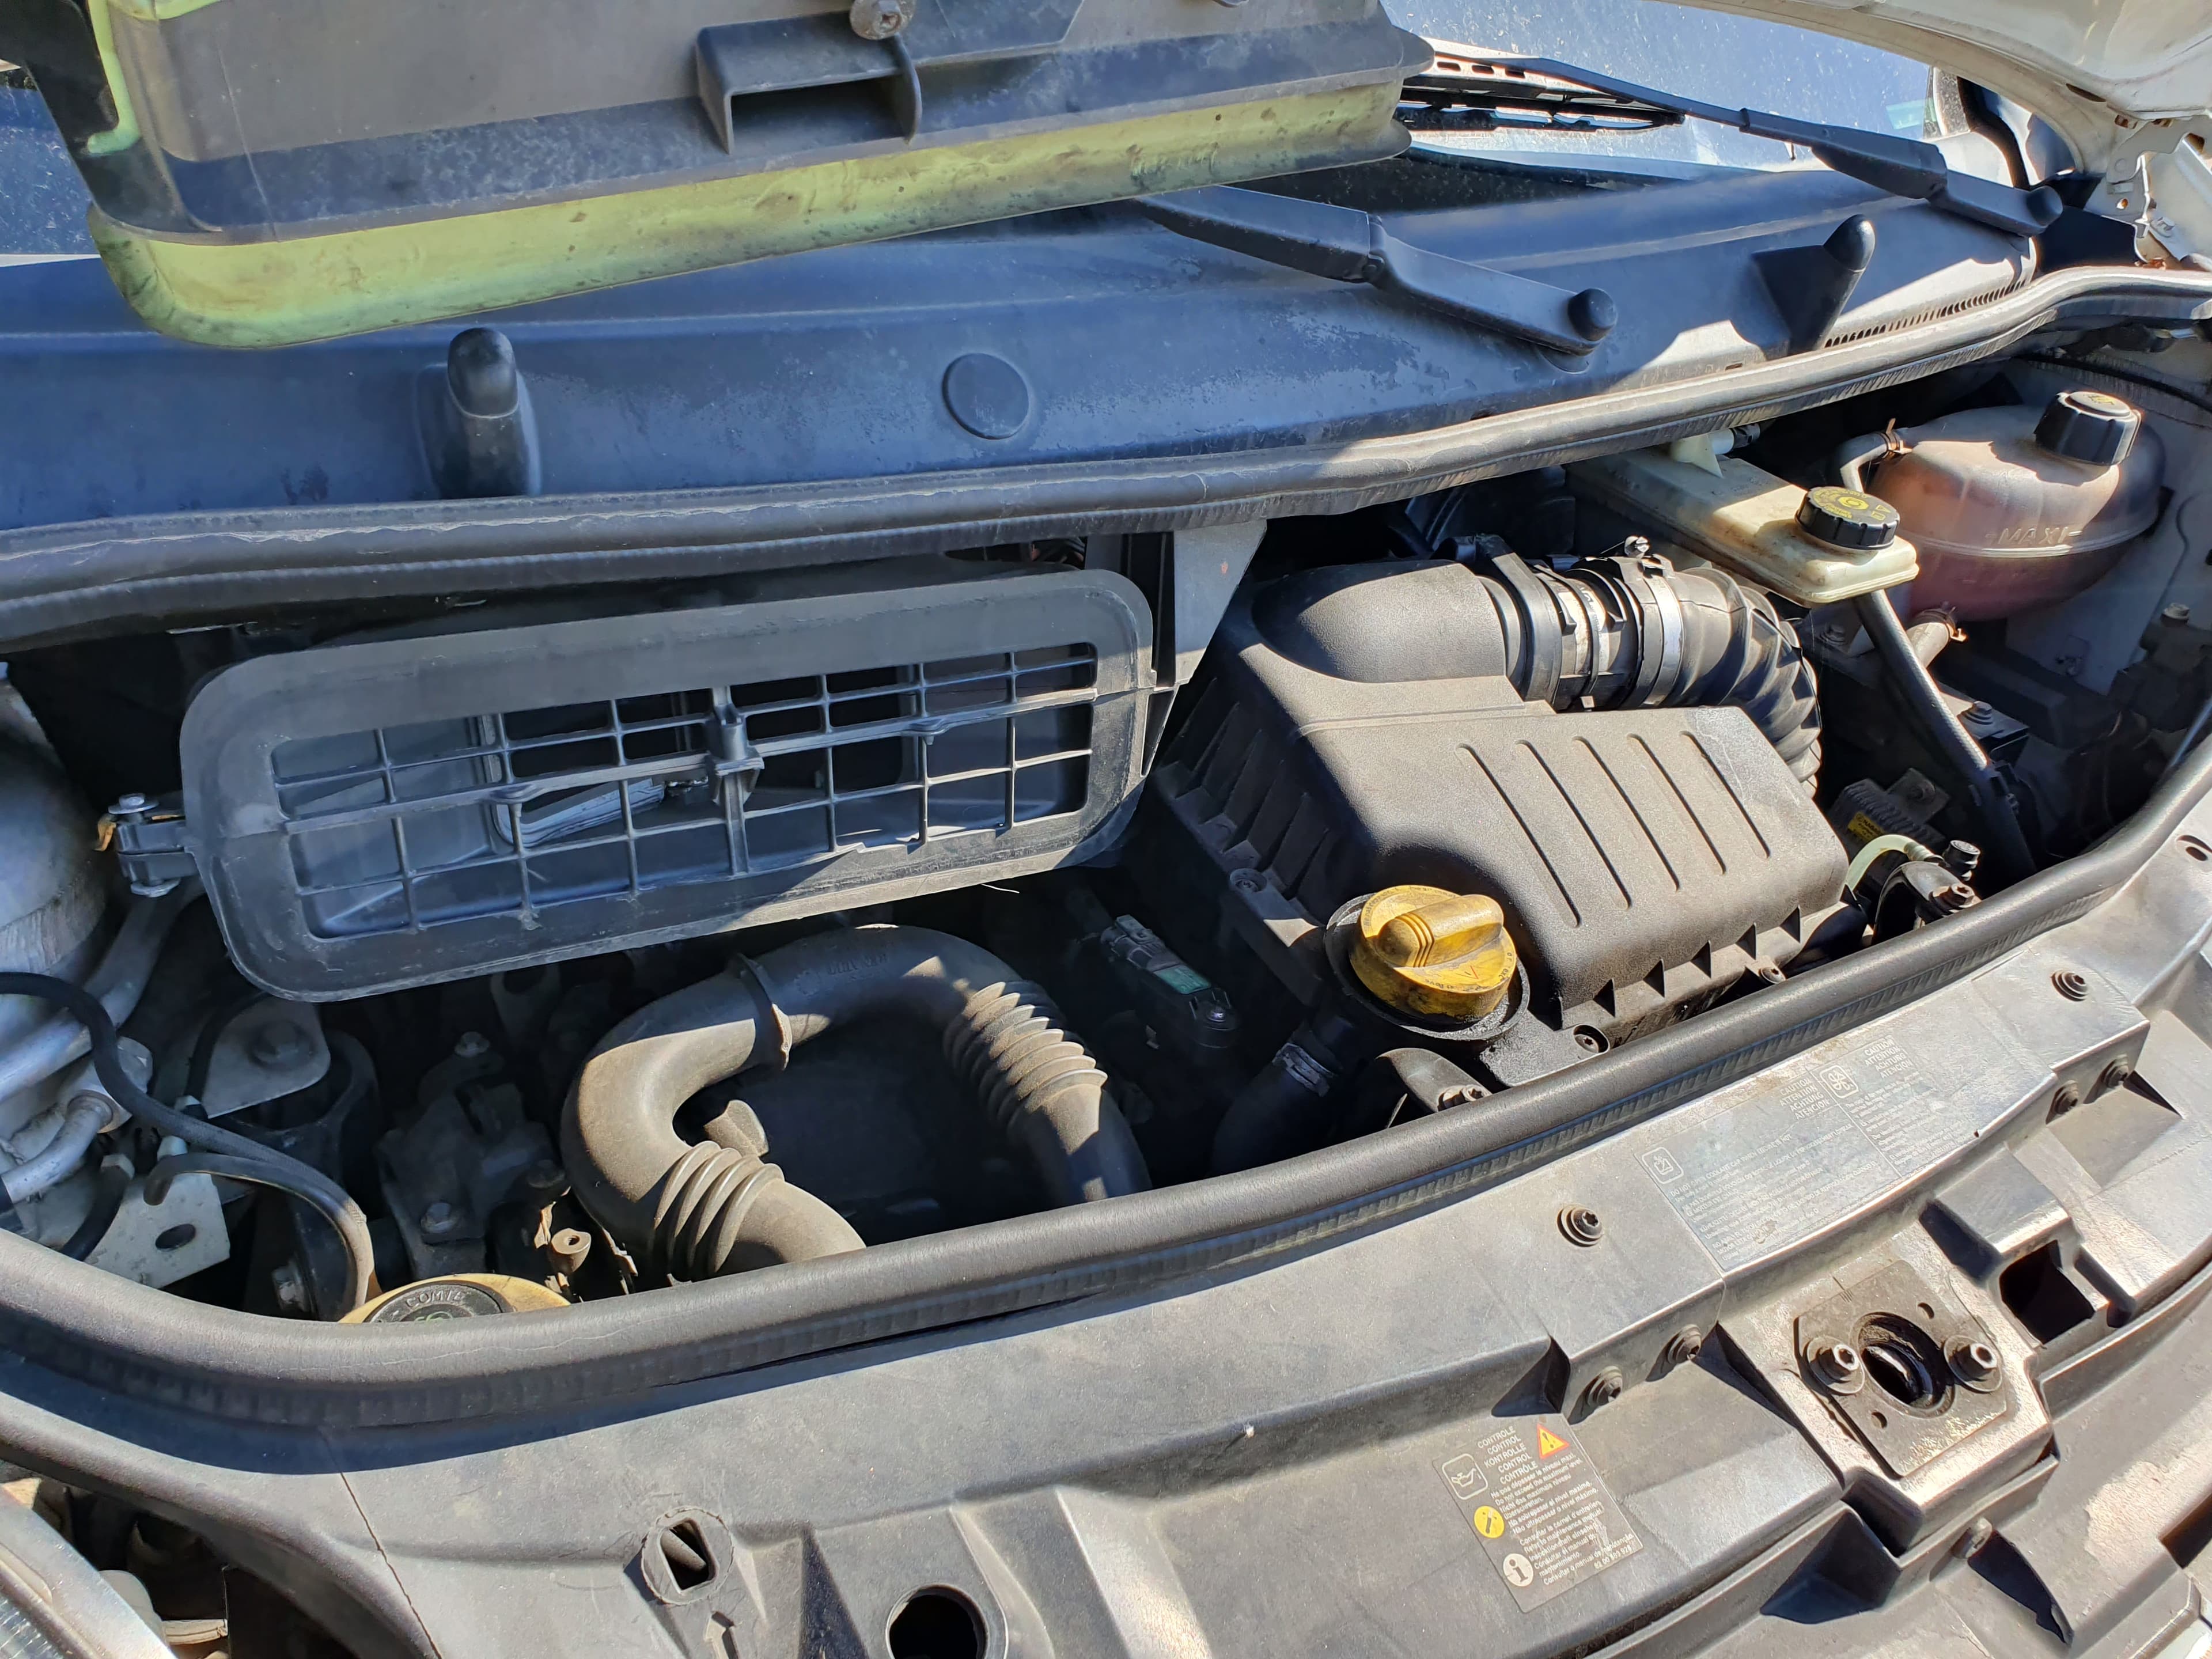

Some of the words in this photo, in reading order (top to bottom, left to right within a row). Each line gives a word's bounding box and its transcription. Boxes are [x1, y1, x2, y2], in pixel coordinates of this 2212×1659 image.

[1476, 1426, 1514, 1448] CONTROLE
[1487, 1435, 1521, 1455] CONTROL
[1484, 1444, 1527, 1468] KONTROLLE
[1498, 1452, 1531, 1472] CONTROL
